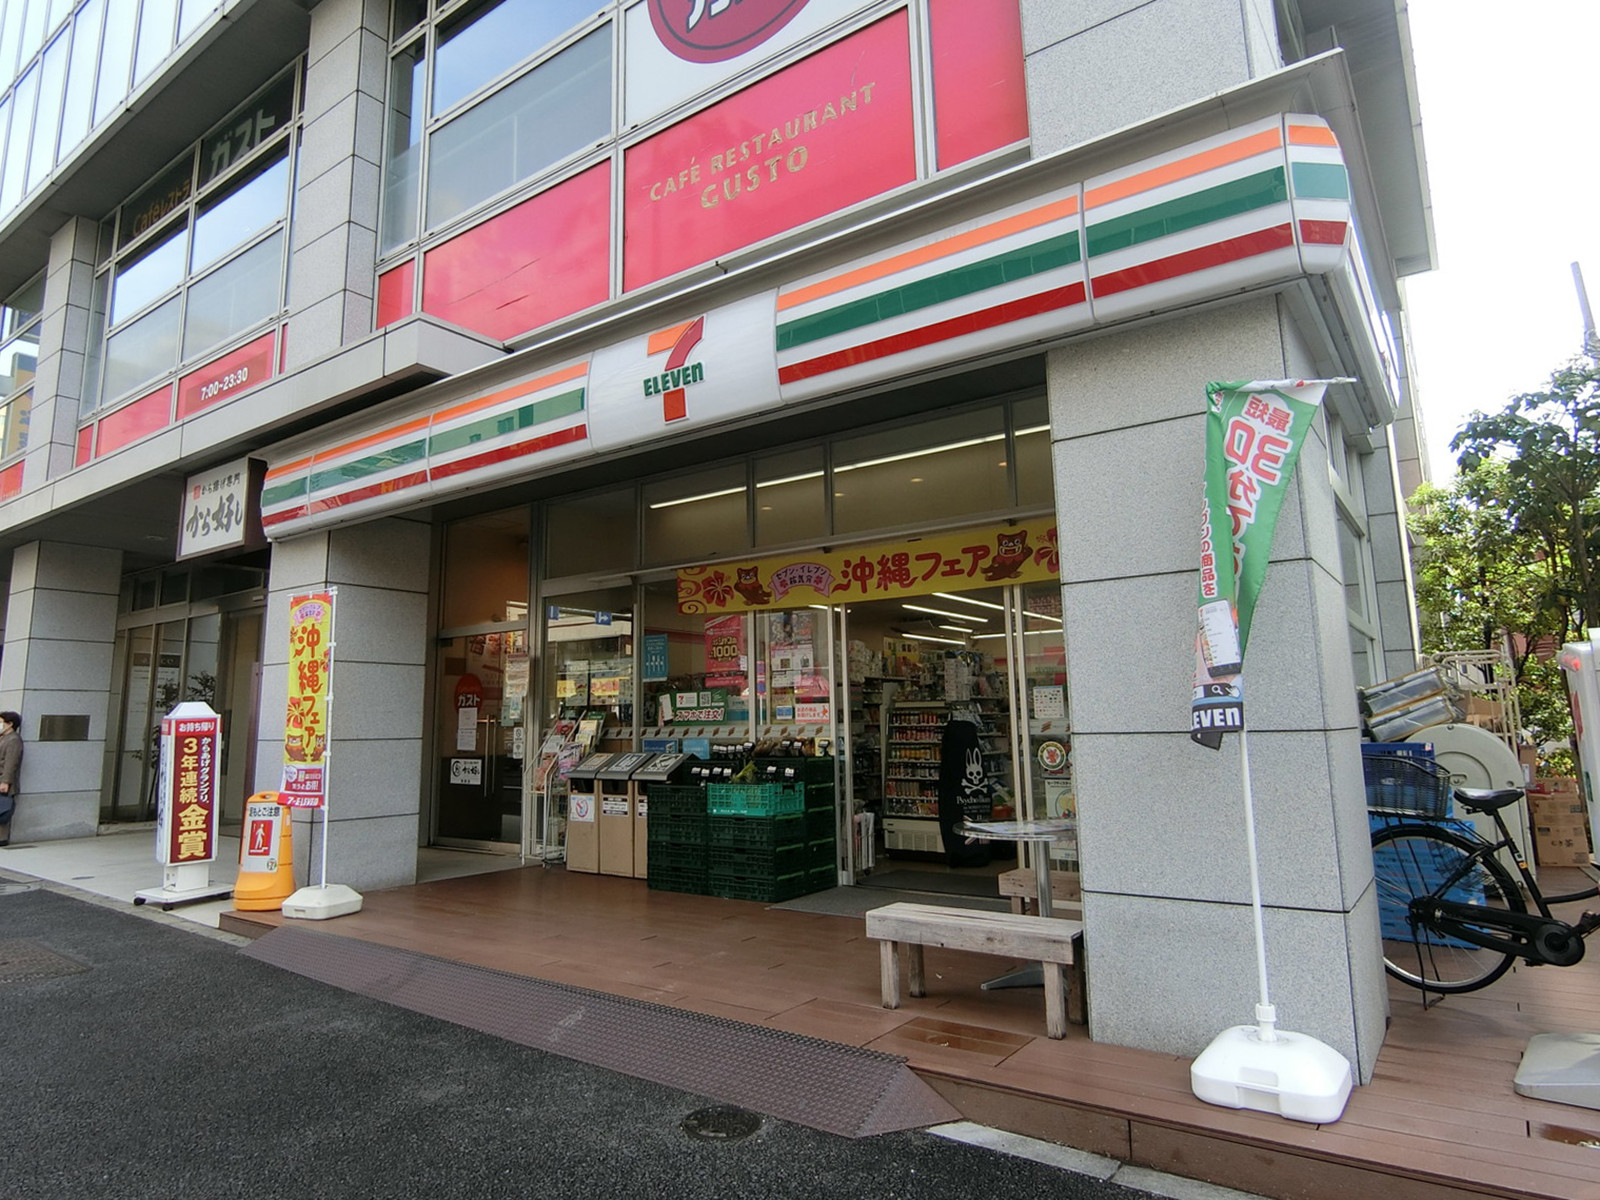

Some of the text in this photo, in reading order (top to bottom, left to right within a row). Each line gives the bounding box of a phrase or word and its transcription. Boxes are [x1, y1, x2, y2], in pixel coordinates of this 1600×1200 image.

[650, 83, 876, 201] CAFÉ RESTAURANT
[701, 146, 809, 209] GUSTO
[186, 492, 243, 539] から好し
[832, 544, 991, 594] 沖縄フェア
[293, 622, 323, 749] 沖縄フェア
[457, 693, 480, 707] ガスト
